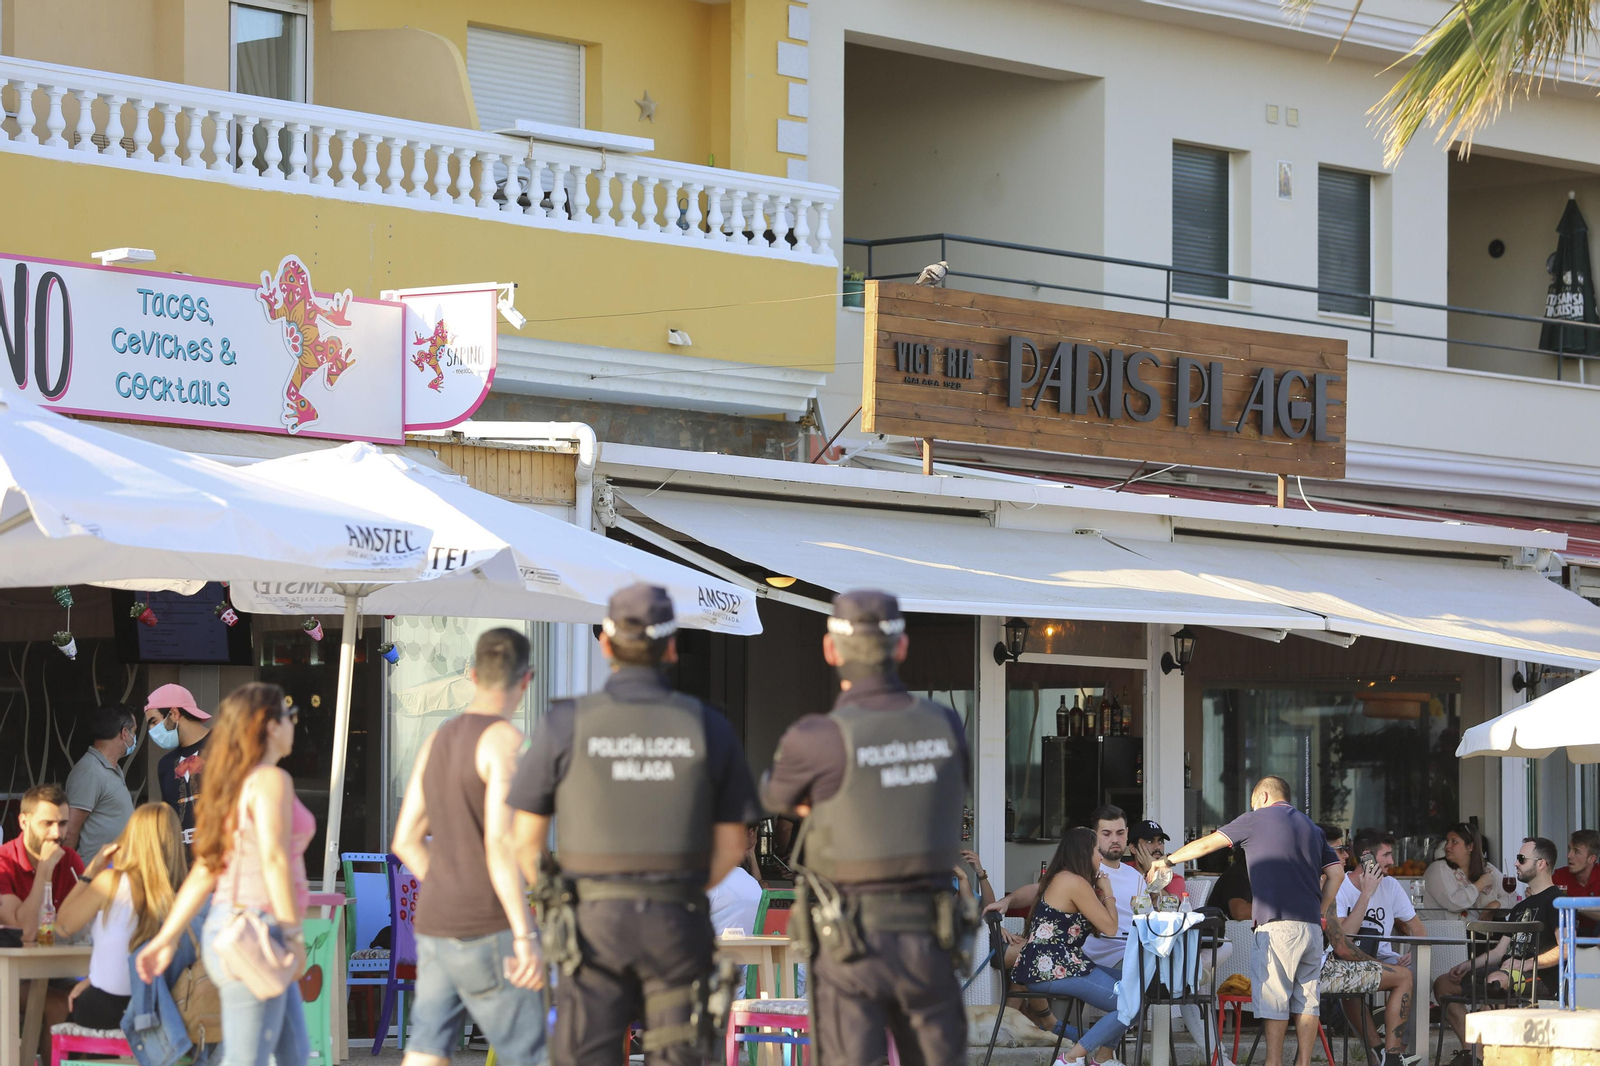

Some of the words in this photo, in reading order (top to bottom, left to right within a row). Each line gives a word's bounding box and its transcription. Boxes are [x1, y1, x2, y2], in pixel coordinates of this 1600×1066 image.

[219, 336, 238, 366] &
[1007, 335, 1162, 423] PARIS
[1176, 356, 1343, 444] PLAGE
[344, 524, 422, 554] AMSTEL
[645, 736, 696, 758] LOCAL
[907, 737, 953, 761] LOCAL
